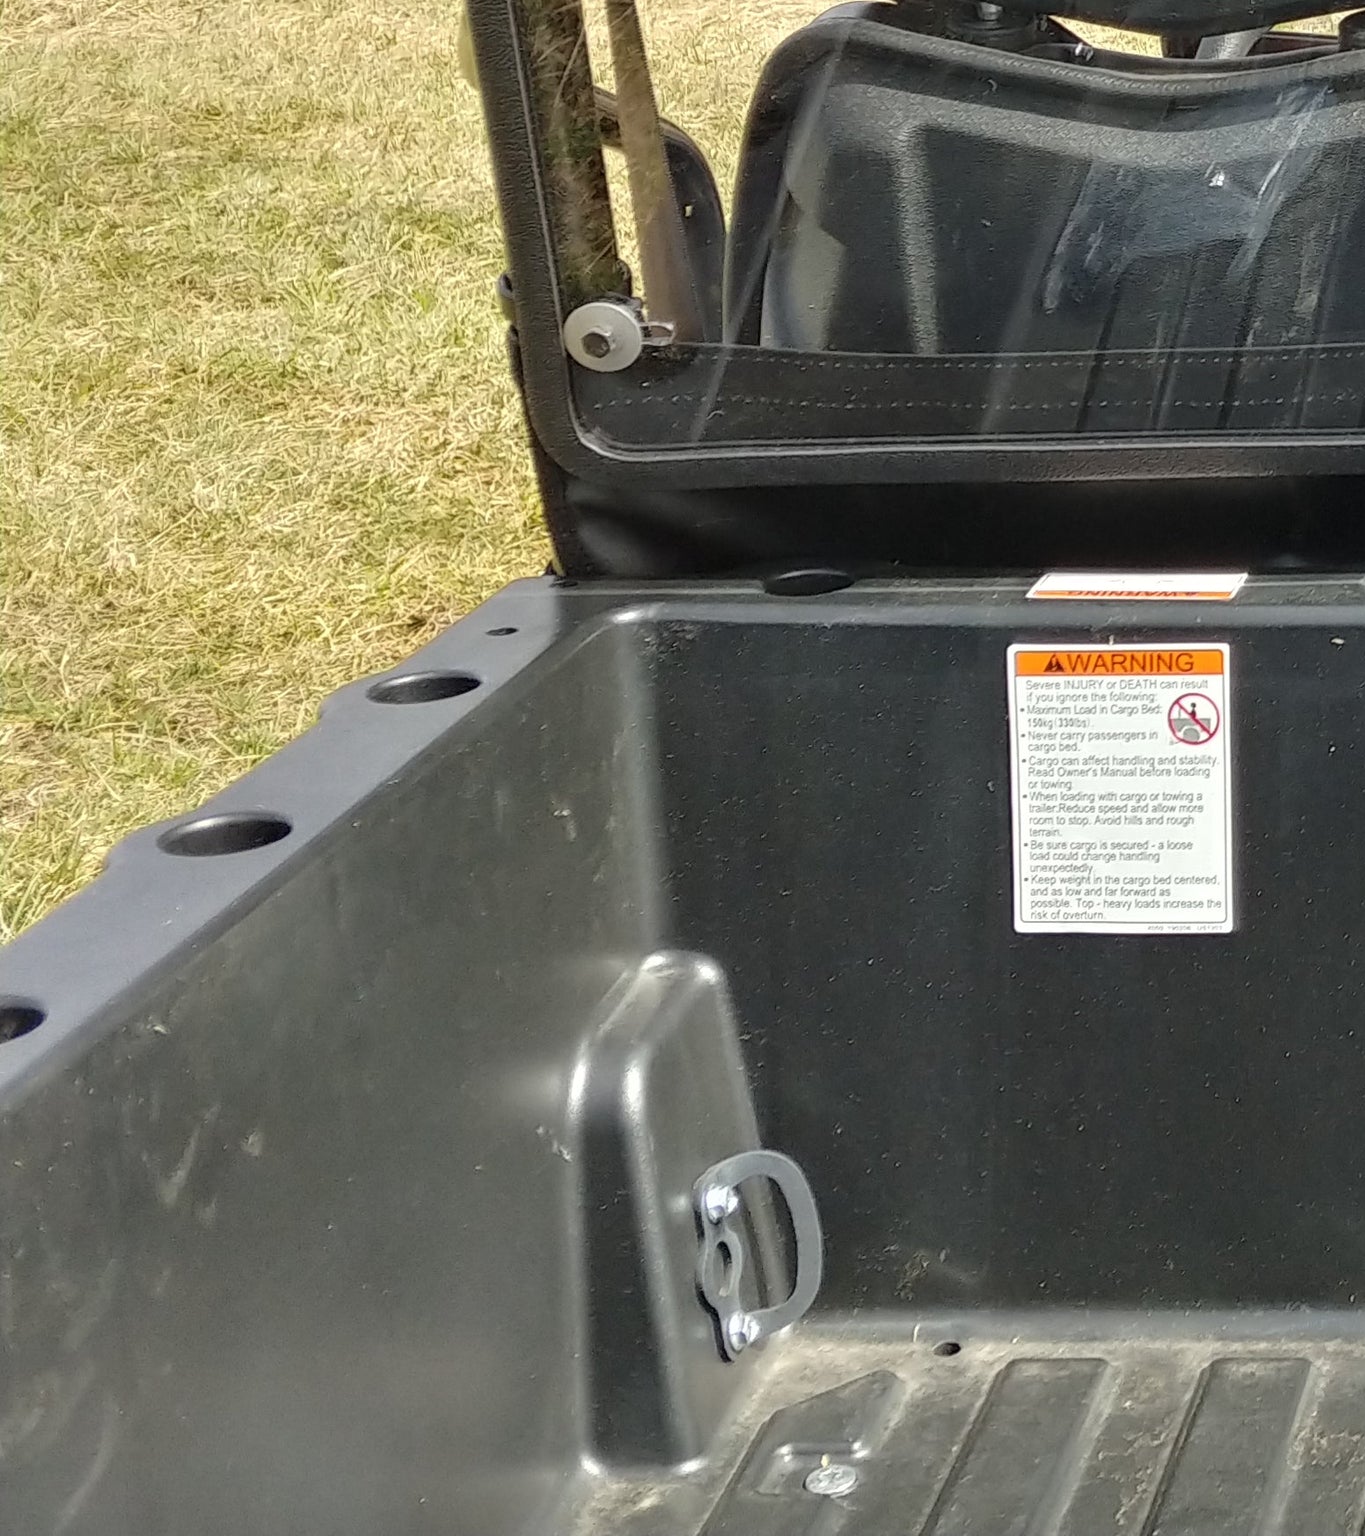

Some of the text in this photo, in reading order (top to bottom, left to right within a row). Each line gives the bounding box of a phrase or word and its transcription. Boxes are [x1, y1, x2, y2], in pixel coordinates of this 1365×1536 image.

[1066, 653, 1194, 673] WARNING
[1026, 680, 1060, 690] Severe
[1064, 680, 1105, 689] INJURY
[1120, 680, 1157, 689] DEATH
[1181, 680, 1208, 689] result
[1027, 692, 1034, 702] if
[1036, 694, 1053, 704] you
[1056, 692, 1088, 704] ignore
[1091, 692, 1107, 701] the
[1027, 705, 1071, 714] Maximum
[1074, 705, 1096, 714] Load
[1100, 706, 1108, 714] in
[1111, 704, 1138, 716] Cargo
[1028, 731, 1158, 742] Never carry passengers in
[1028, 744, 1055, 753] cargo
[1029, 756, 1058, 767] Cargo
[1082, 755, 1110, 765] affect
[1112, 756, 1155, 767] handling
[1157, 756, 1176, 765] and
[1028, 767, 1054, 777] Read
[1100, 767, 1137, 777] Manual
[1139, 766, 1171, 777] before
[1174, 766, 1210, 779] loading
[1028, 781, 1038, 789] or
[1030, 792, 1057, 801] When
[1060, 792, 1095, 803] loading
[1098, 792, 1117, 801] with
[1120, 794, 1147, 803] cargo
[1162, 792, 1194, 803] towing
[1098, 804, 1128, 815] speed
[1131, 804, 1148, 813] and
[1152, 804, 1176, 813] allow
[1179, 805, 1204, 813] more
[1029, 817, 1054, 825] room
[1056, 816, 1065, 825] to
[1094, 816, 1121, 825] Avoid
[1124, 816, 1143, 825] hills
[1146, 816, 1163, 825] and
[1167, 816, 1194, 827] rough
[1031, 841, 1043, 850] Be
[1047, 842, 1068, 850] sure
[1070, 842, 1097, 852] cargo
[1100, 841, 1108, 850] is
[1111, 840, 1149, 850] secured
[1167, 840, 1193, 850] loose
[1030, 851, 1160, 863] load could change handling
[1031, 876, 1056, 886] Keep
[1059, 875, 1091, 886] weight
[1094, 875, 1102, 884] in
[1105, 875, 1120, 884] the
[1123, 877, 1150, 887] cargo
[1153, 875, 1171, 884] bed
[1031, 888, 1048, 896] and
[1065, 887, 1081, 896] low
[1084, 887, 1102, 896] and
[1104, 887, 1117, 896] far
[1120, 887, 1156, 896] forward
[1076, 899, 1094, 909] Top
[1103, 899, 1132, 911] heavy
[1134, 899, 1161, 908] loads
[1164, 899, 1204, 908] increase
[1207, 898, 1221, 908] the
[1031, 911, 1047, 919] risk
[1051, 911, 1061, 919] of
